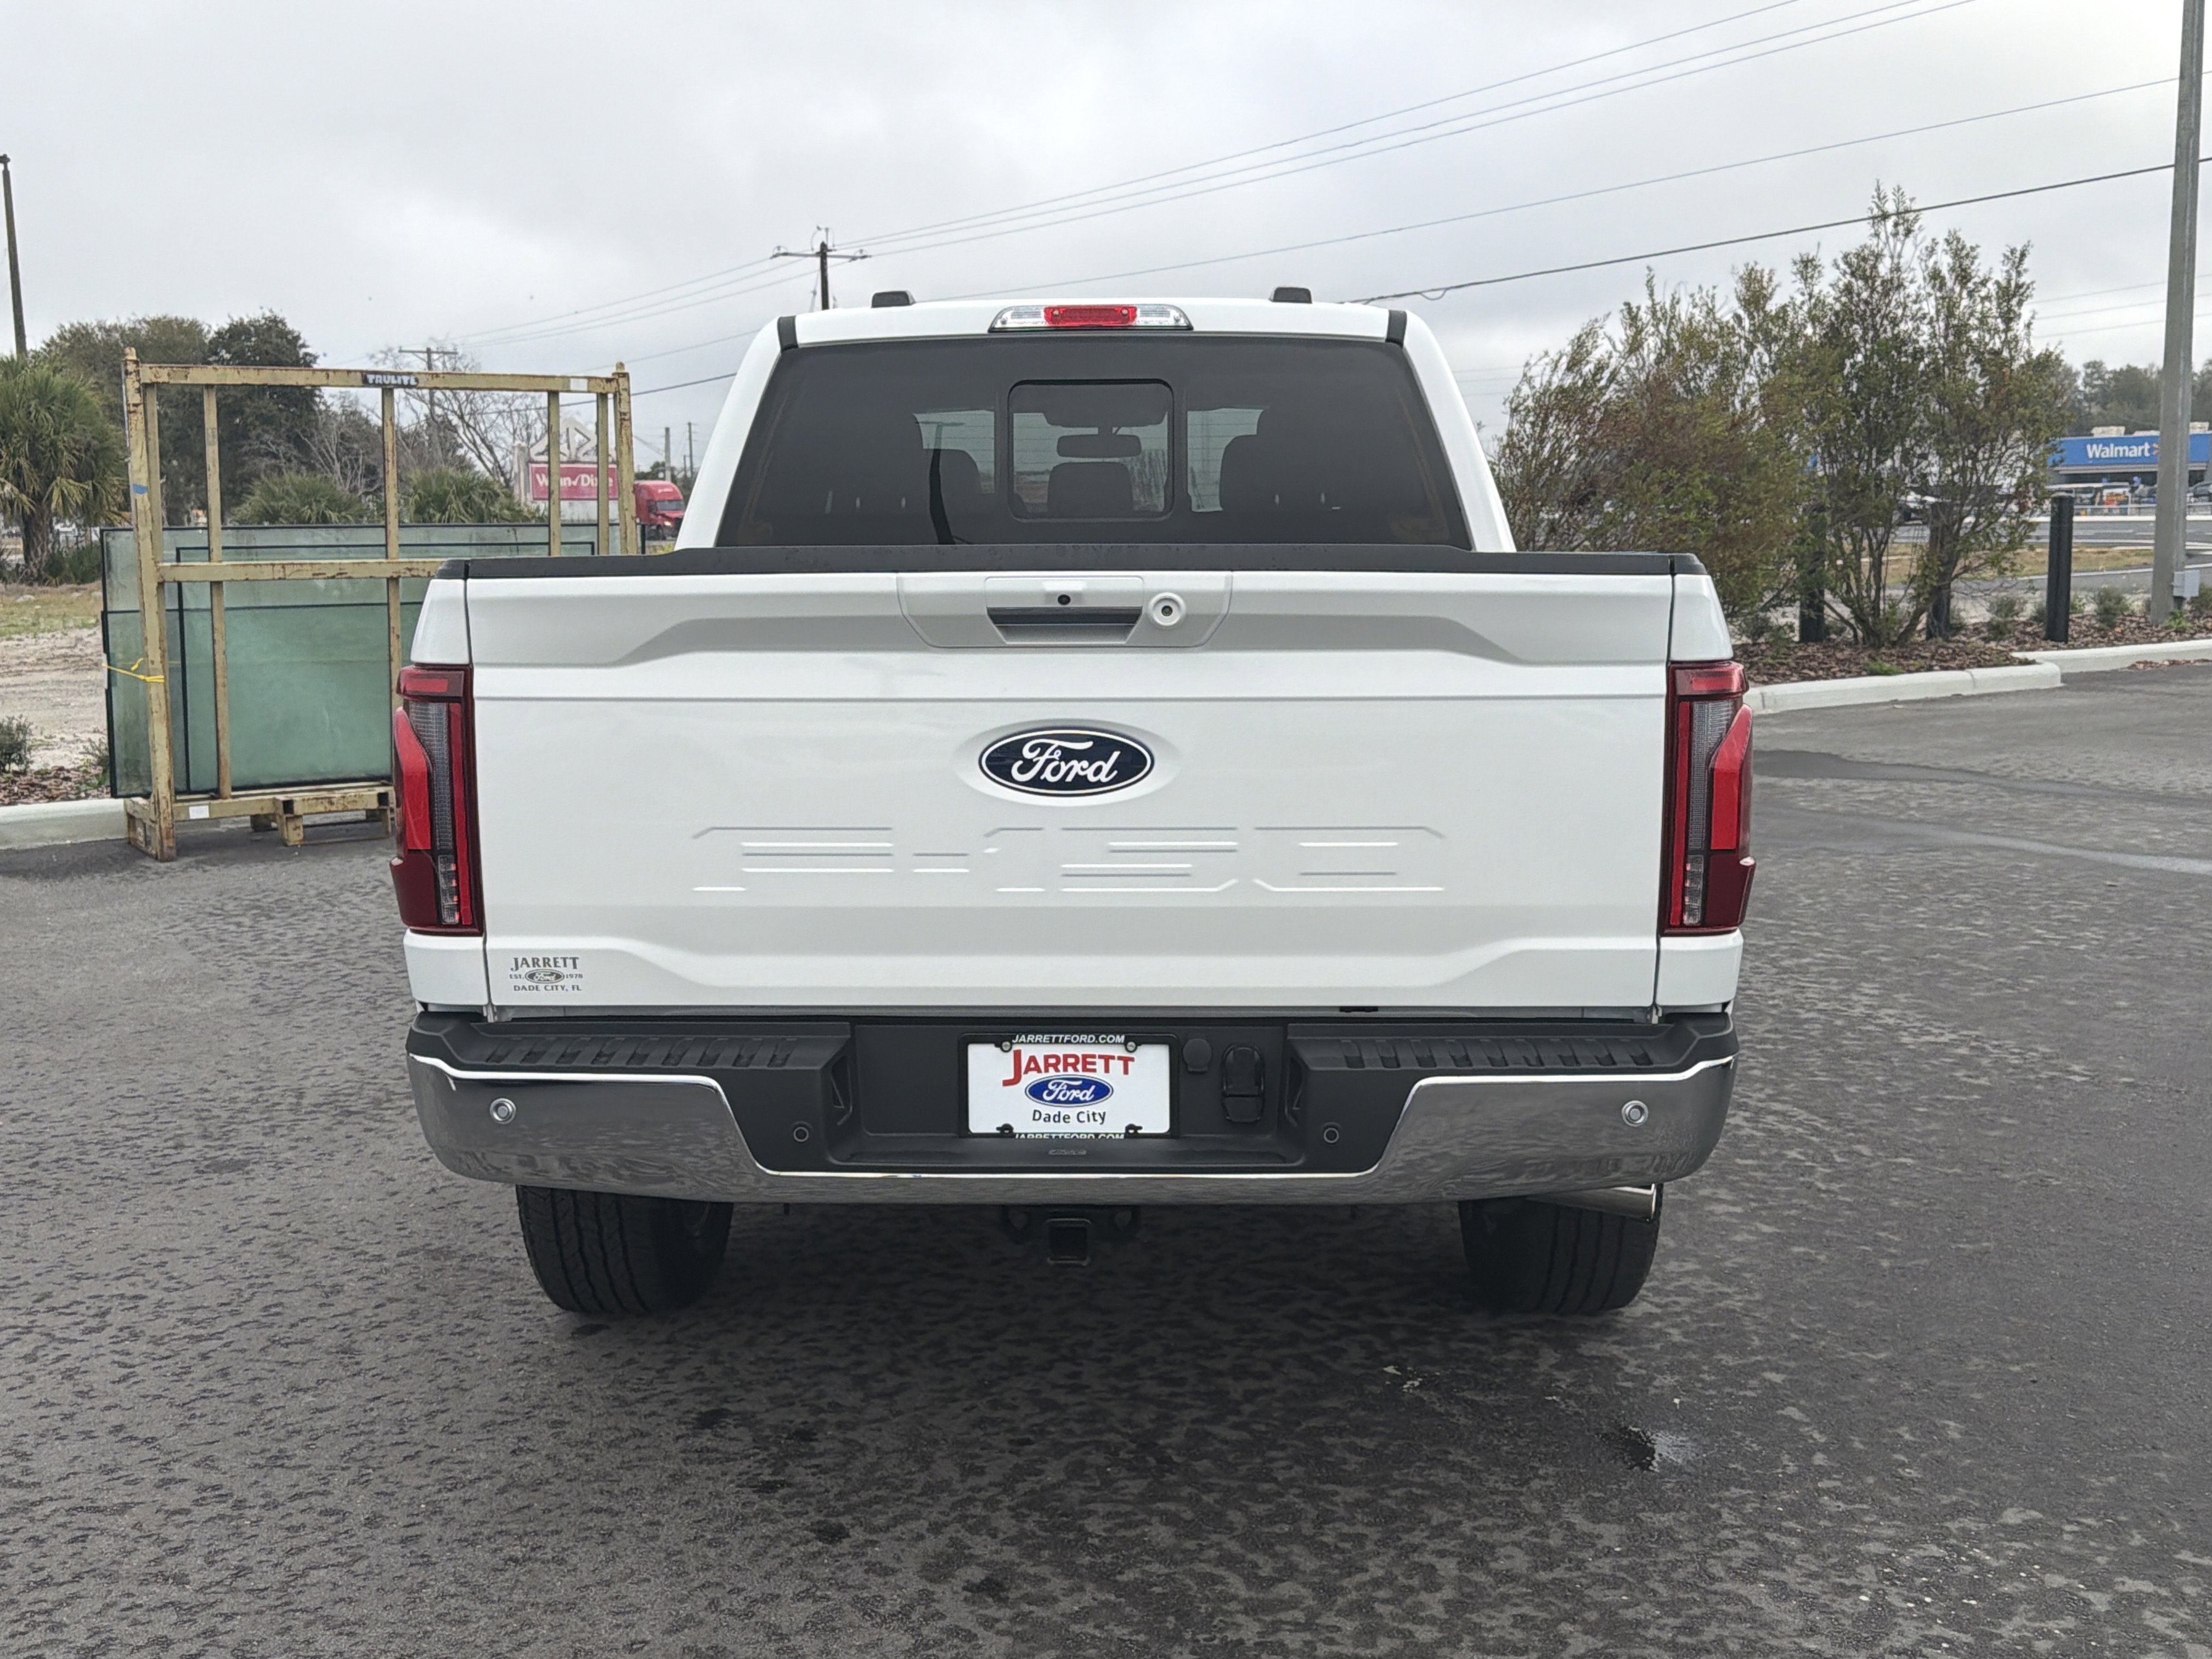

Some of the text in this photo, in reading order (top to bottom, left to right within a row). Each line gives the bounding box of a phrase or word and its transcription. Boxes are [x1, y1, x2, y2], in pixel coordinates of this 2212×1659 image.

[2086, 442, 2151, 458] Walmart
[1011, 738, 1121, 783] Ford
[692, 827, 1446, 891] F-150
[510, 957, 579, 972] JARRETT
[1012, 1034, 1125, 1043] JARRETTFORD.COM
[1002, 1049, 1135, 1087] JARRETT
[1043, 1079, 1095, 1101] Ford
[1032, 1109, 1107, 1125] Dade City
